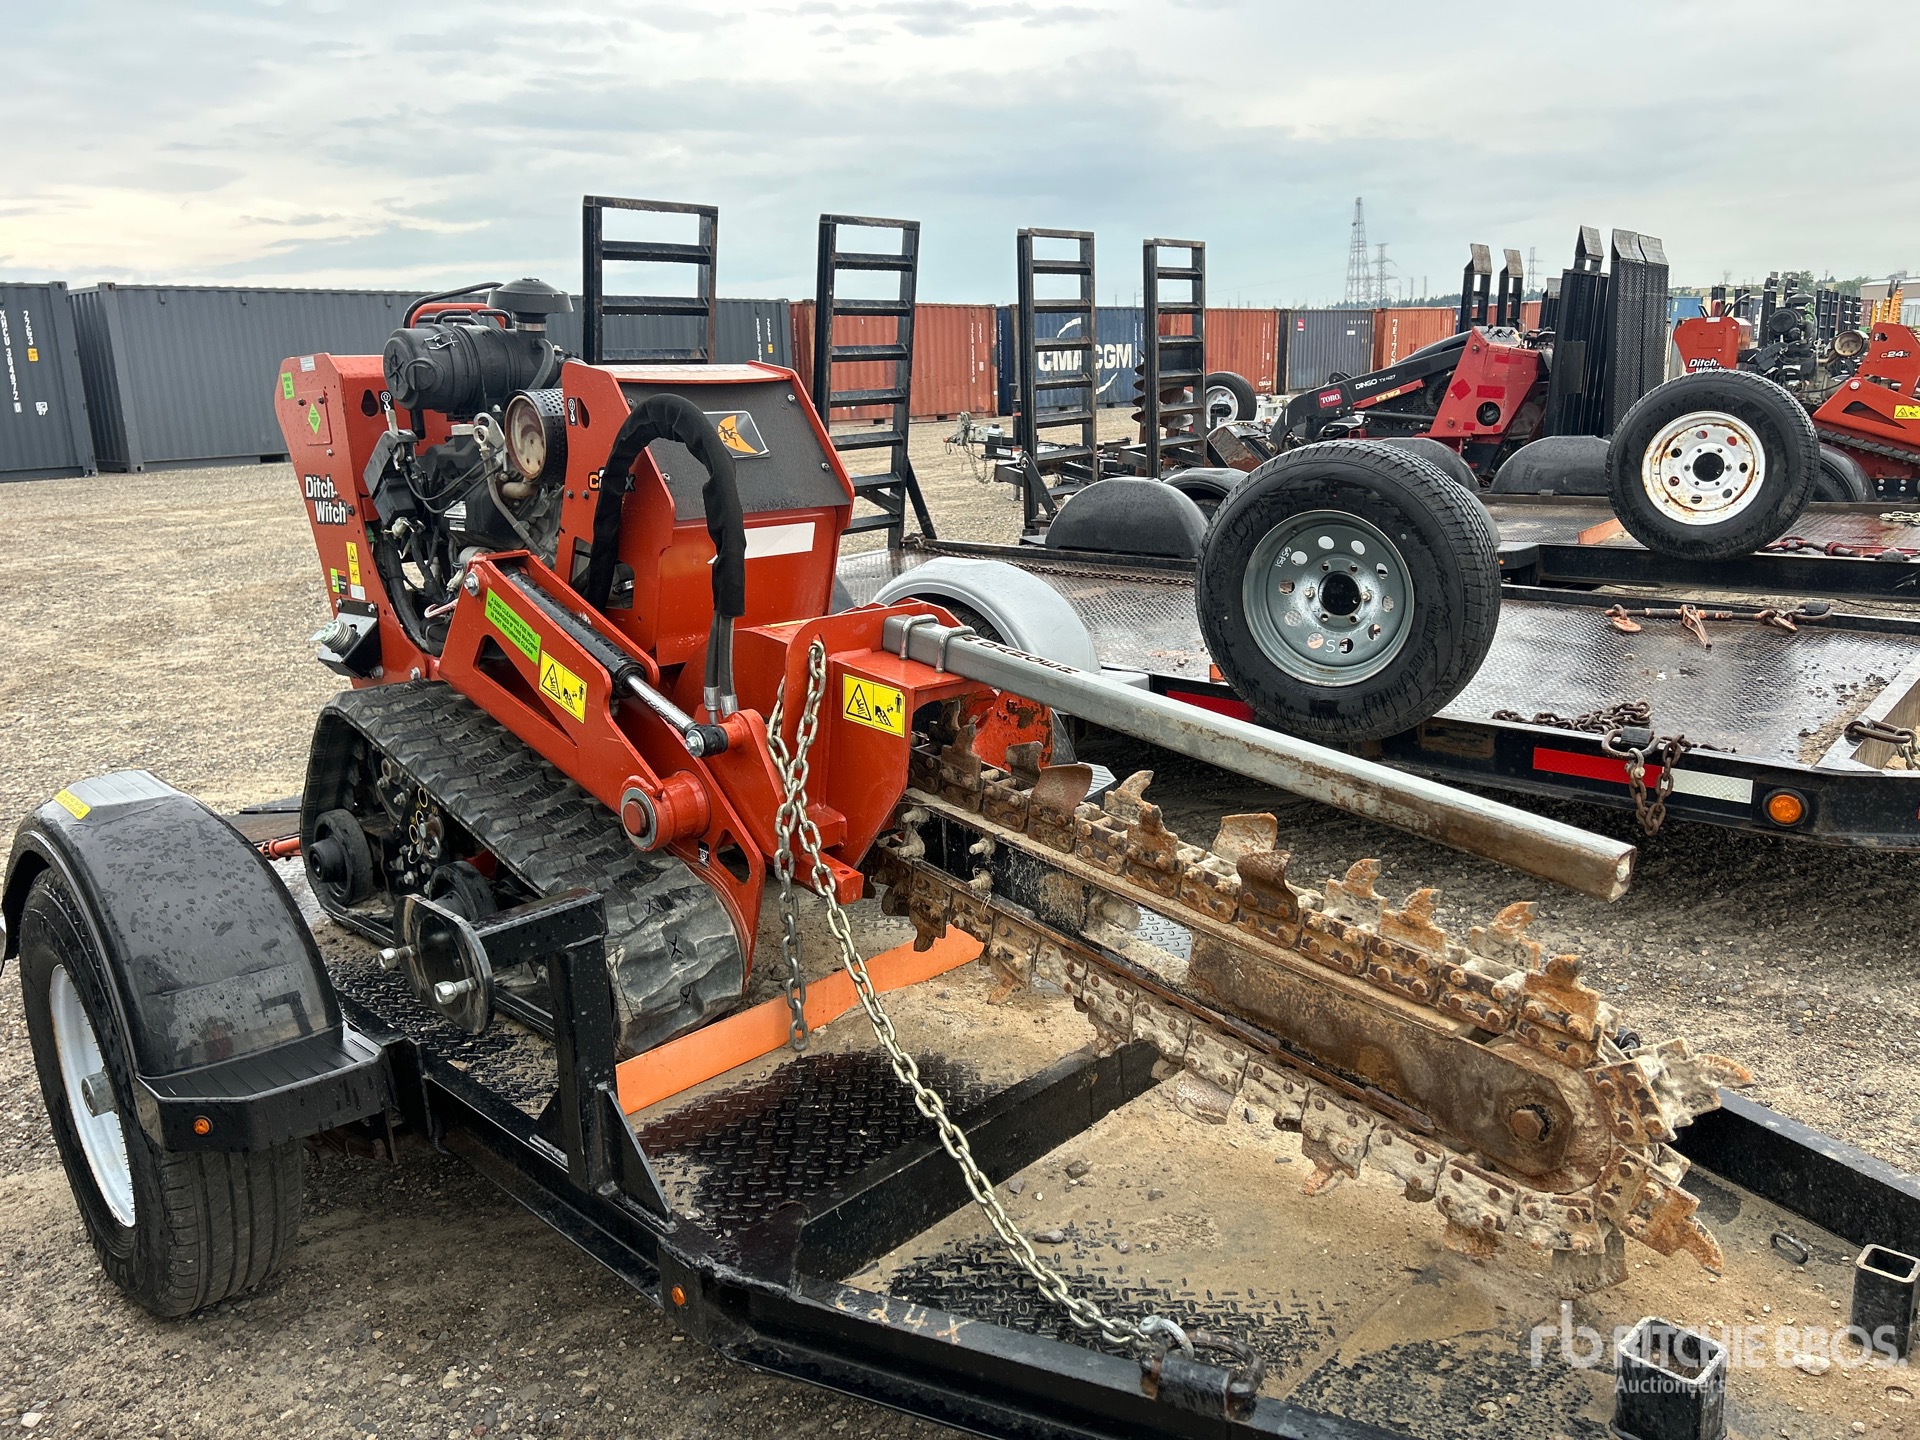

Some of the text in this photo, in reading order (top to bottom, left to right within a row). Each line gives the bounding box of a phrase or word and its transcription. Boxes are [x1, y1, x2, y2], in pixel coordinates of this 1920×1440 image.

[1689, 358, 1717, 367] Ditch
[1355, 379, 1378, 390] DINGO
[1320, 394, 1340, 404] TORO
[305, 476, 334, 498] Ditch
[315, 501, 346, 523] Witch
